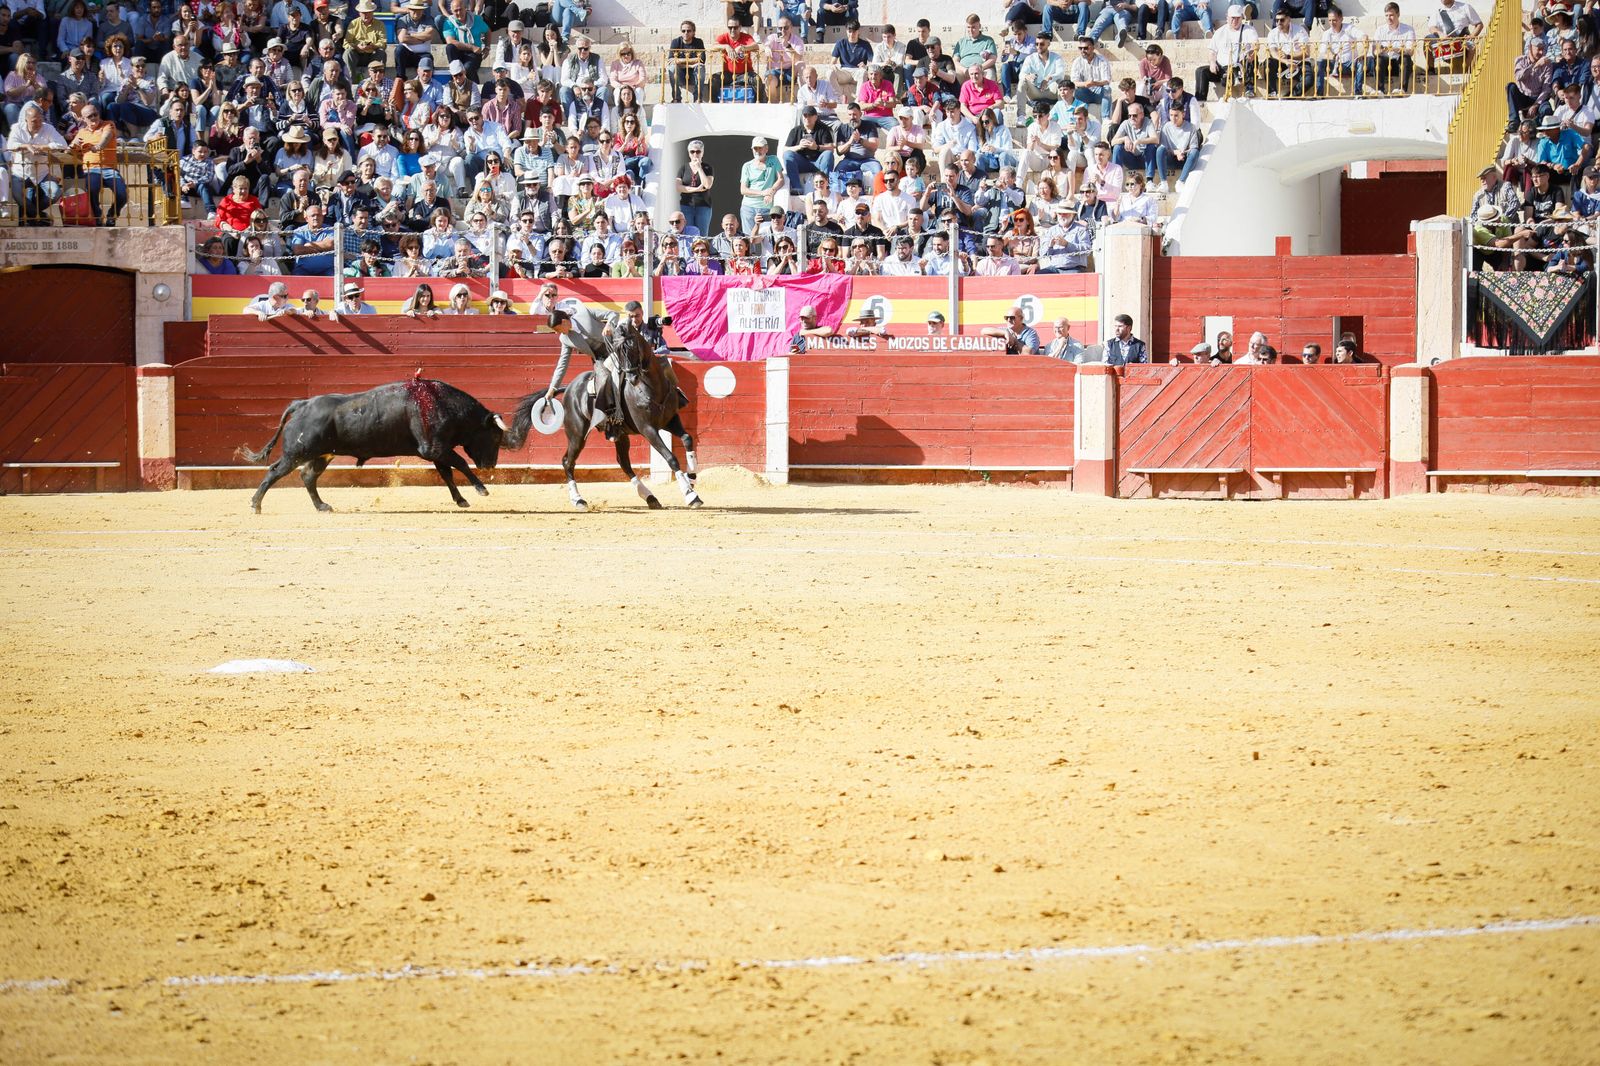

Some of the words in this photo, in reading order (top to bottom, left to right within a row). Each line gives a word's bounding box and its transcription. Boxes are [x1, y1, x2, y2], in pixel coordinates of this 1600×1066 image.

[5, 241, 39, 250] AGOSTO
[42, 242, 53, 250] DE
[57, 241, 78, 250] 1888
[869, 298, 884, 324] 5
[1020, 297, 1034, 324] 5
[807, 336, 877, 350] MAYORALES
[888, 336, 930, 350] MOZOS
[933, 337, 947, 350] DE
[950, 336, 1007, 350] CABALLOS
